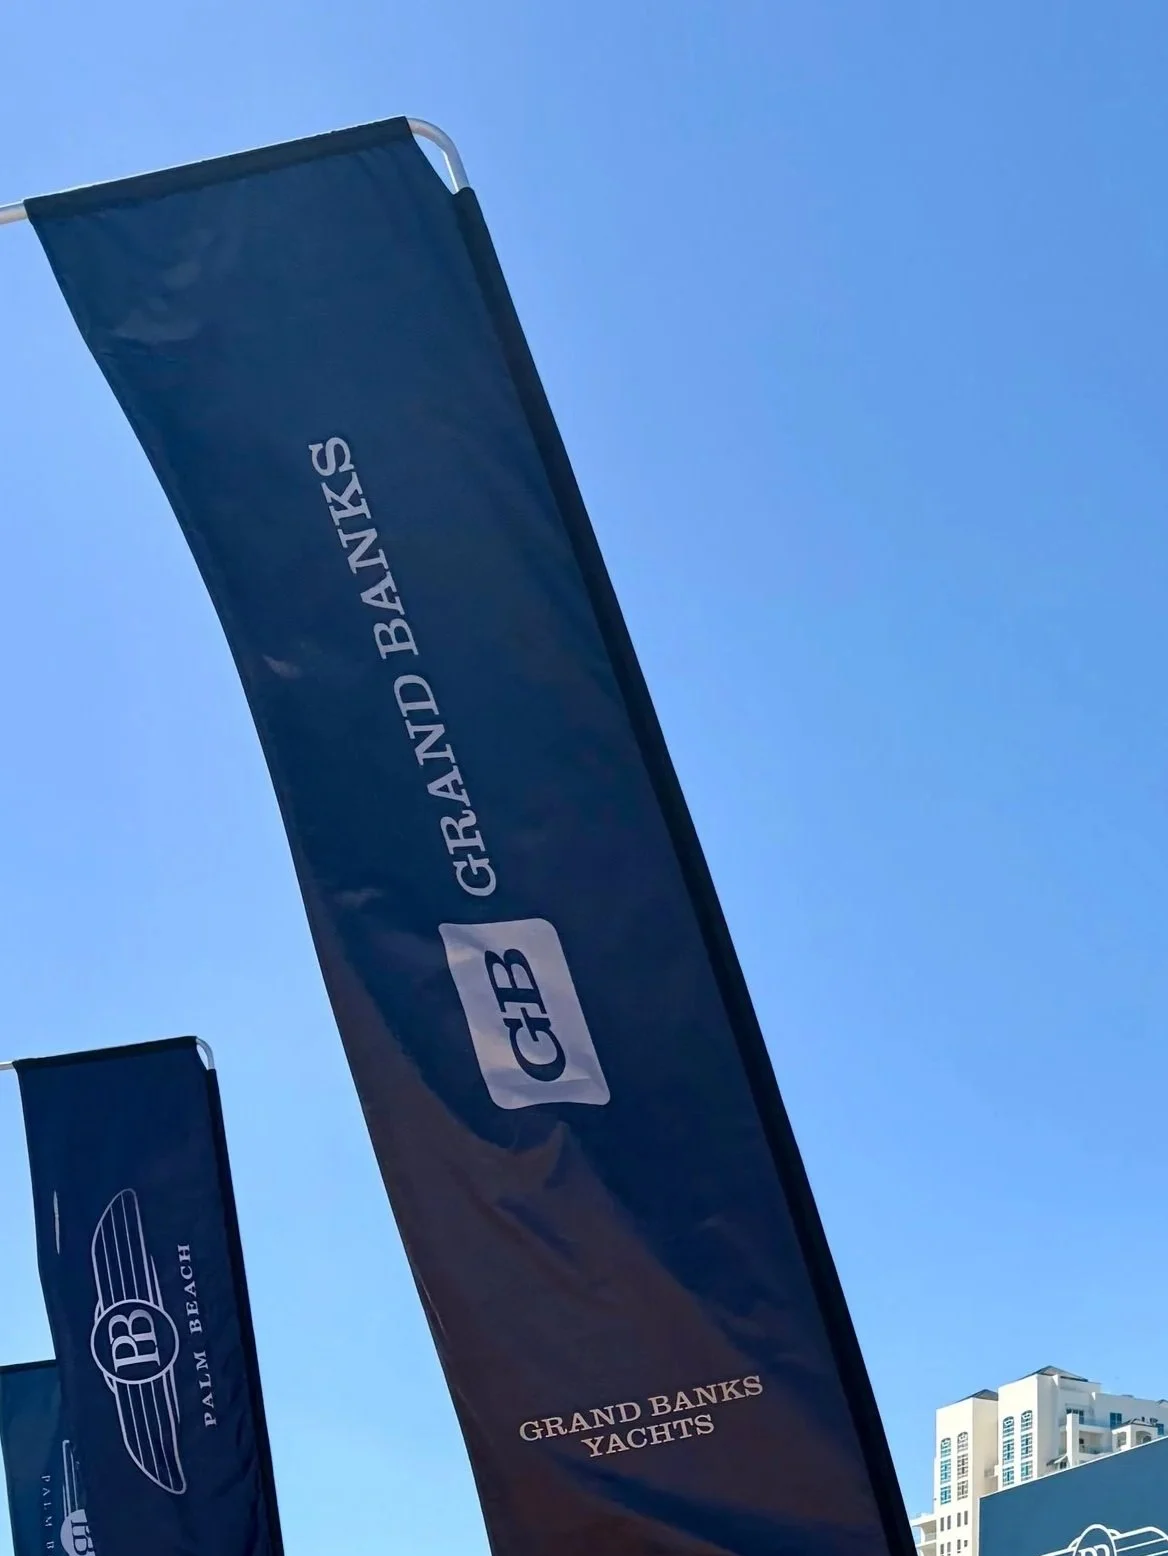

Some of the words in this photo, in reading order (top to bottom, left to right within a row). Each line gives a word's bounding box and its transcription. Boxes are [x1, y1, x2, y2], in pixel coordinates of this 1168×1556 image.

[309, 436, 419, 658] BANKS
[394, 674, 497, 896] GRAND
[484, 946, 567, 1083] GB
[177, 1244, 203, 1335] BEACH
[108, 1309, 160, 1373] PB
[193, 1350, 217, 1428] PALM
[519, 1402, 641, 1441] GRAND
[648, 1375, 763, 1417] BANKS
[580, 1414, 715, 1458] YACHTS
[41, 1475, 52, 1527] PALM
